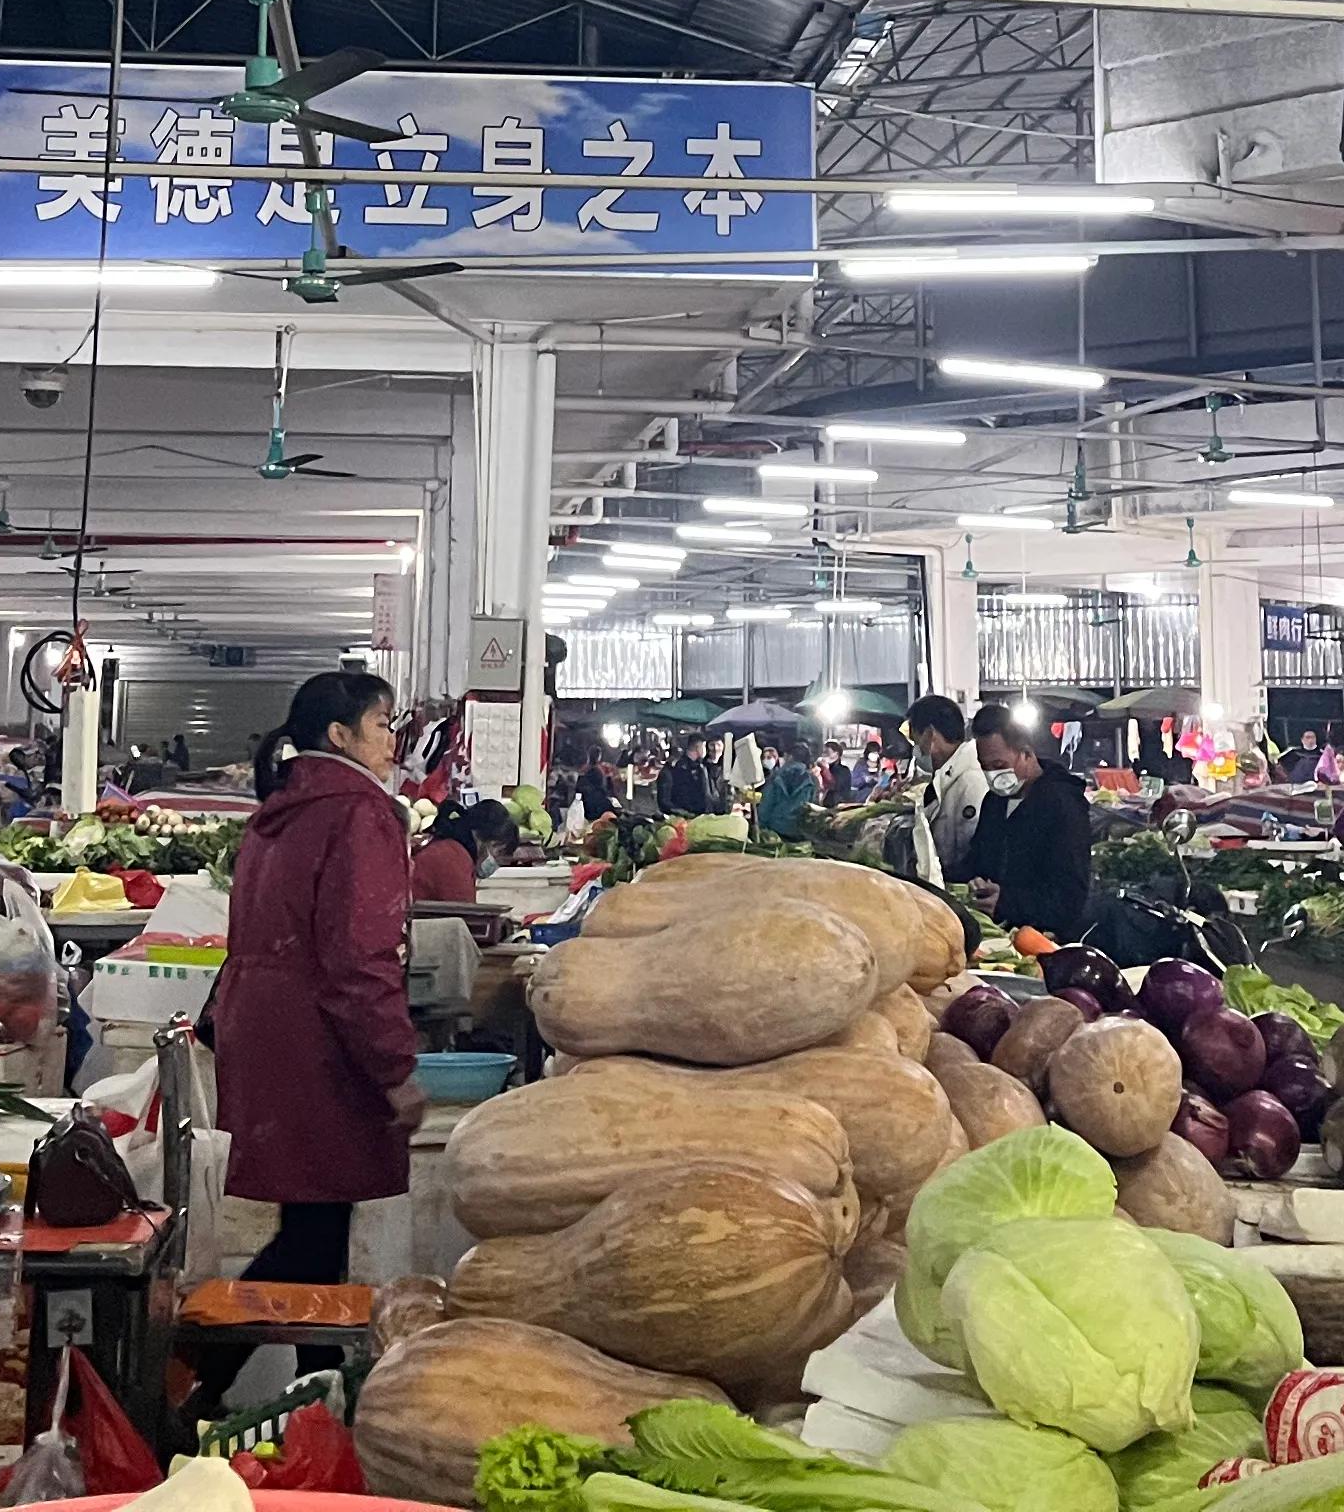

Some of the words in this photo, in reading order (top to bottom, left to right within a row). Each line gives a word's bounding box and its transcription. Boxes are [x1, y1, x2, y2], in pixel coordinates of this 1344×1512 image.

[34, 105, 763, 237] 美德是立身之本
